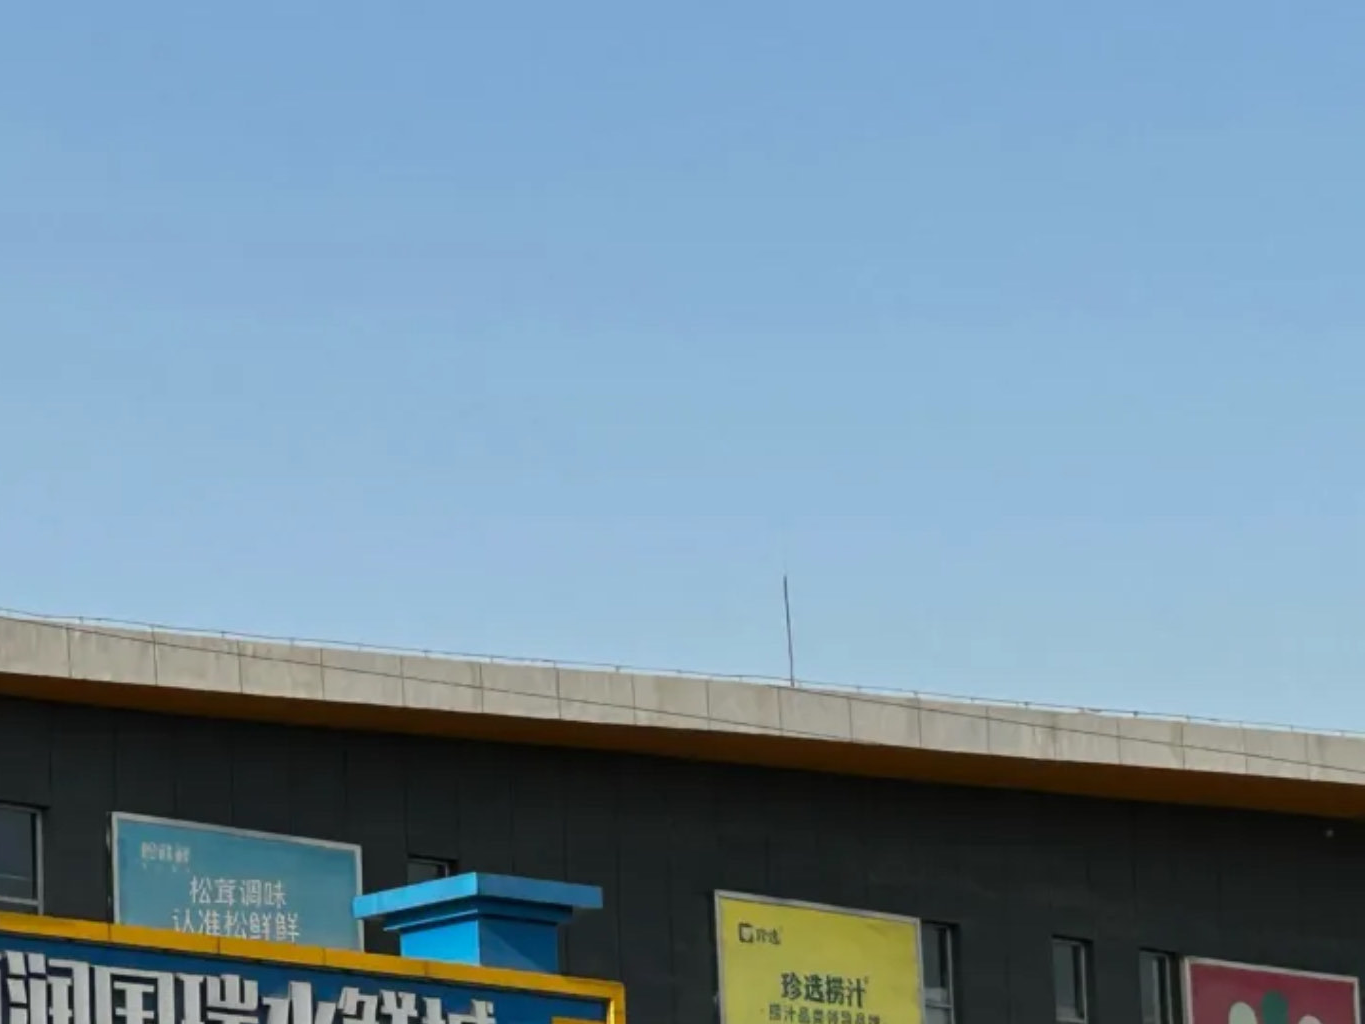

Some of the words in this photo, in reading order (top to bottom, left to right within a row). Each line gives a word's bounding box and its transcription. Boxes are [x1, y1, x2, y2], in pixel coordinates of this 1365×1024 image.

[189, 876, 287, 909] 松茸调味
[172, 908, 300, 943] 认准松鲜鲜
[780, 972, 866, 1008] 珍选捞汁
